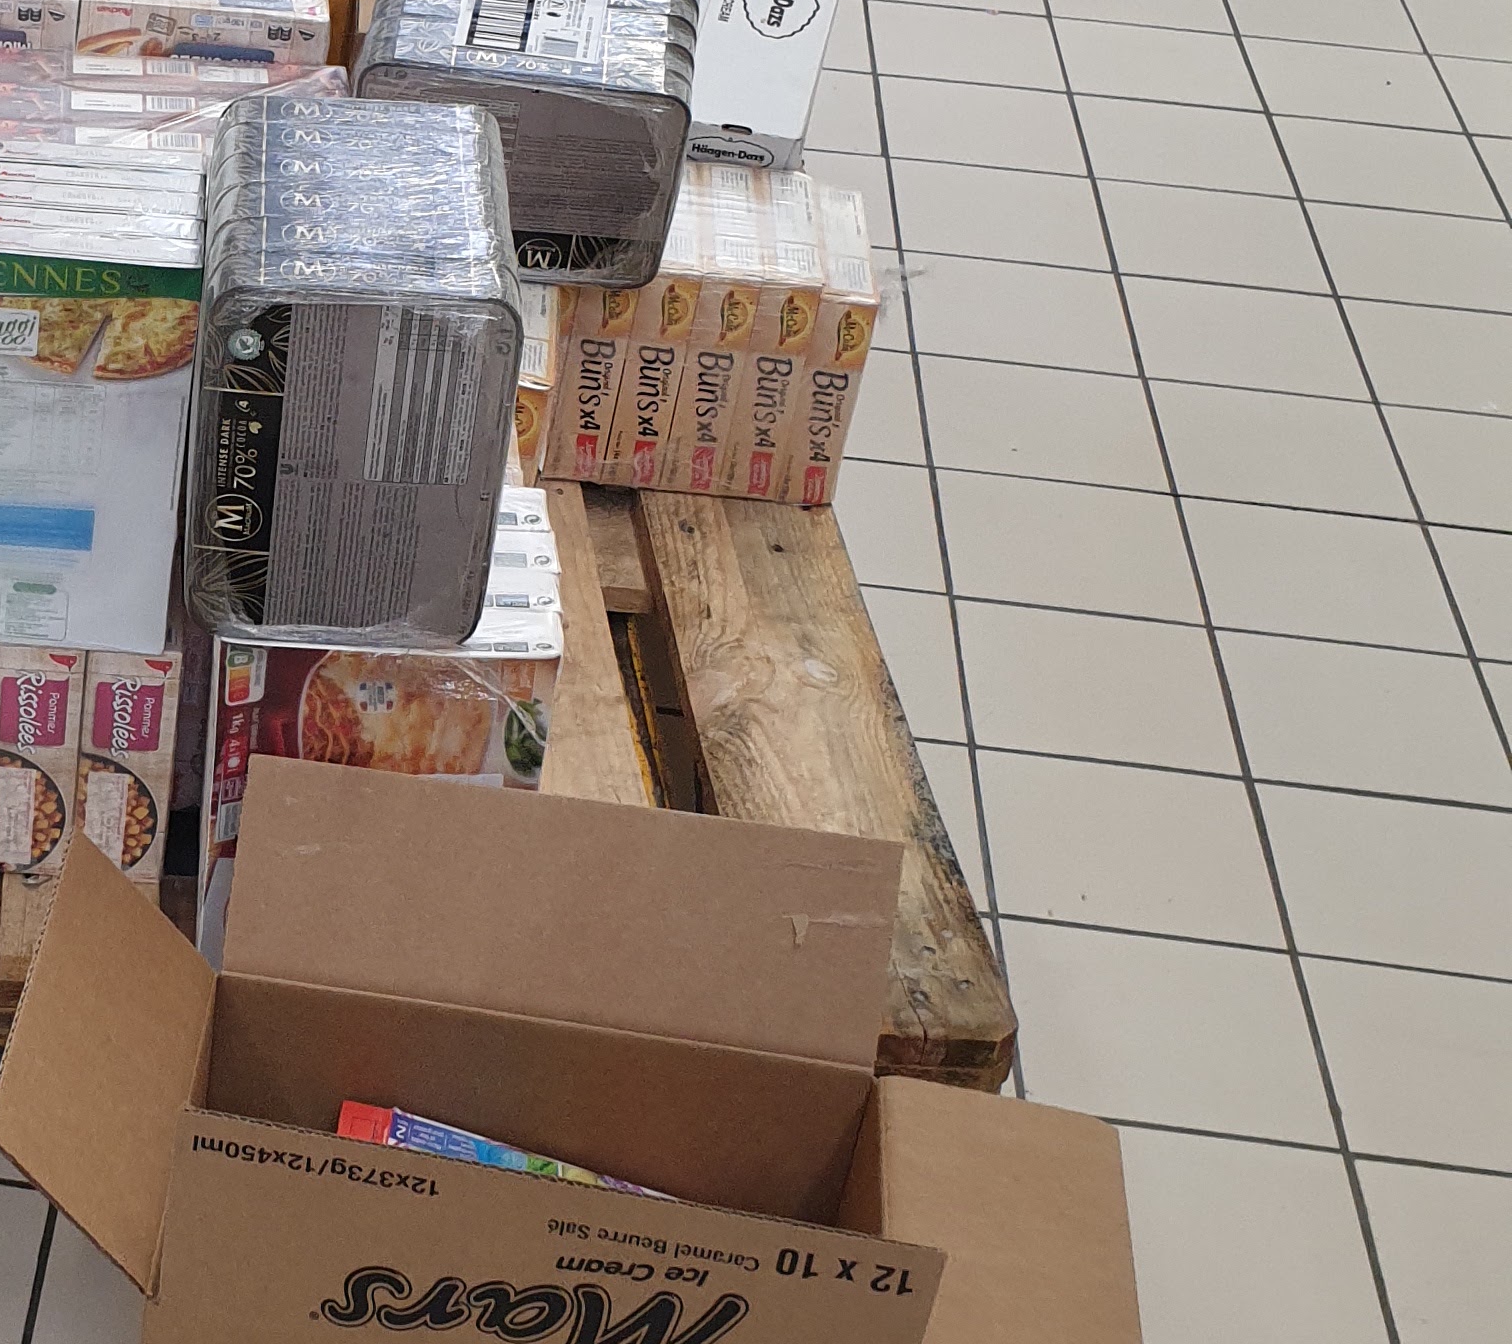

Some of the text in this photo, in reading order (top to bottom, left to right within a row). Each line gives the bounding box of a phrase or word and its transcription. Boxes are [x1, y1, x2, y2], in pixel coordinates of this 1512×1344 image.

[718, 0, 736, 23] CREAM
[691, 143, 765, 162] Häagen-Dazs
[578, 339, 616, 405] Bun's
[636, 345, 676, 413] Bun's
[695, 351, 735, 419] Bun's
[754, 356, 794, 425] Bun's
[579, 408, 601, 431] x4
[638, 414, 659, 437] x4
[808, 369, 849, 439] Bun's
[217, 418, 231, 488] INTENSE DARK
[233, 420, 258, 491] 70% COCOA
[697, 421, 718, 443] x4
[754, 427, 777, 449] x4
[809, 440, 831, 463] x4
[16, 670, 47, 755] Rissolées
[47, 692, 60, 735] Pommes
[110, 676, 142, 760] Rissolées
[141, 697, 156, 739] Pommes
[191, 1133, 442, 1197] 12x373g/12x450ml
[547, 1218, 760, 1273] Caramel Beurre Salé
[554, 1255, 710, 1287] Ice Cream
[775, 1247, 914, 1296] 12 x 10
